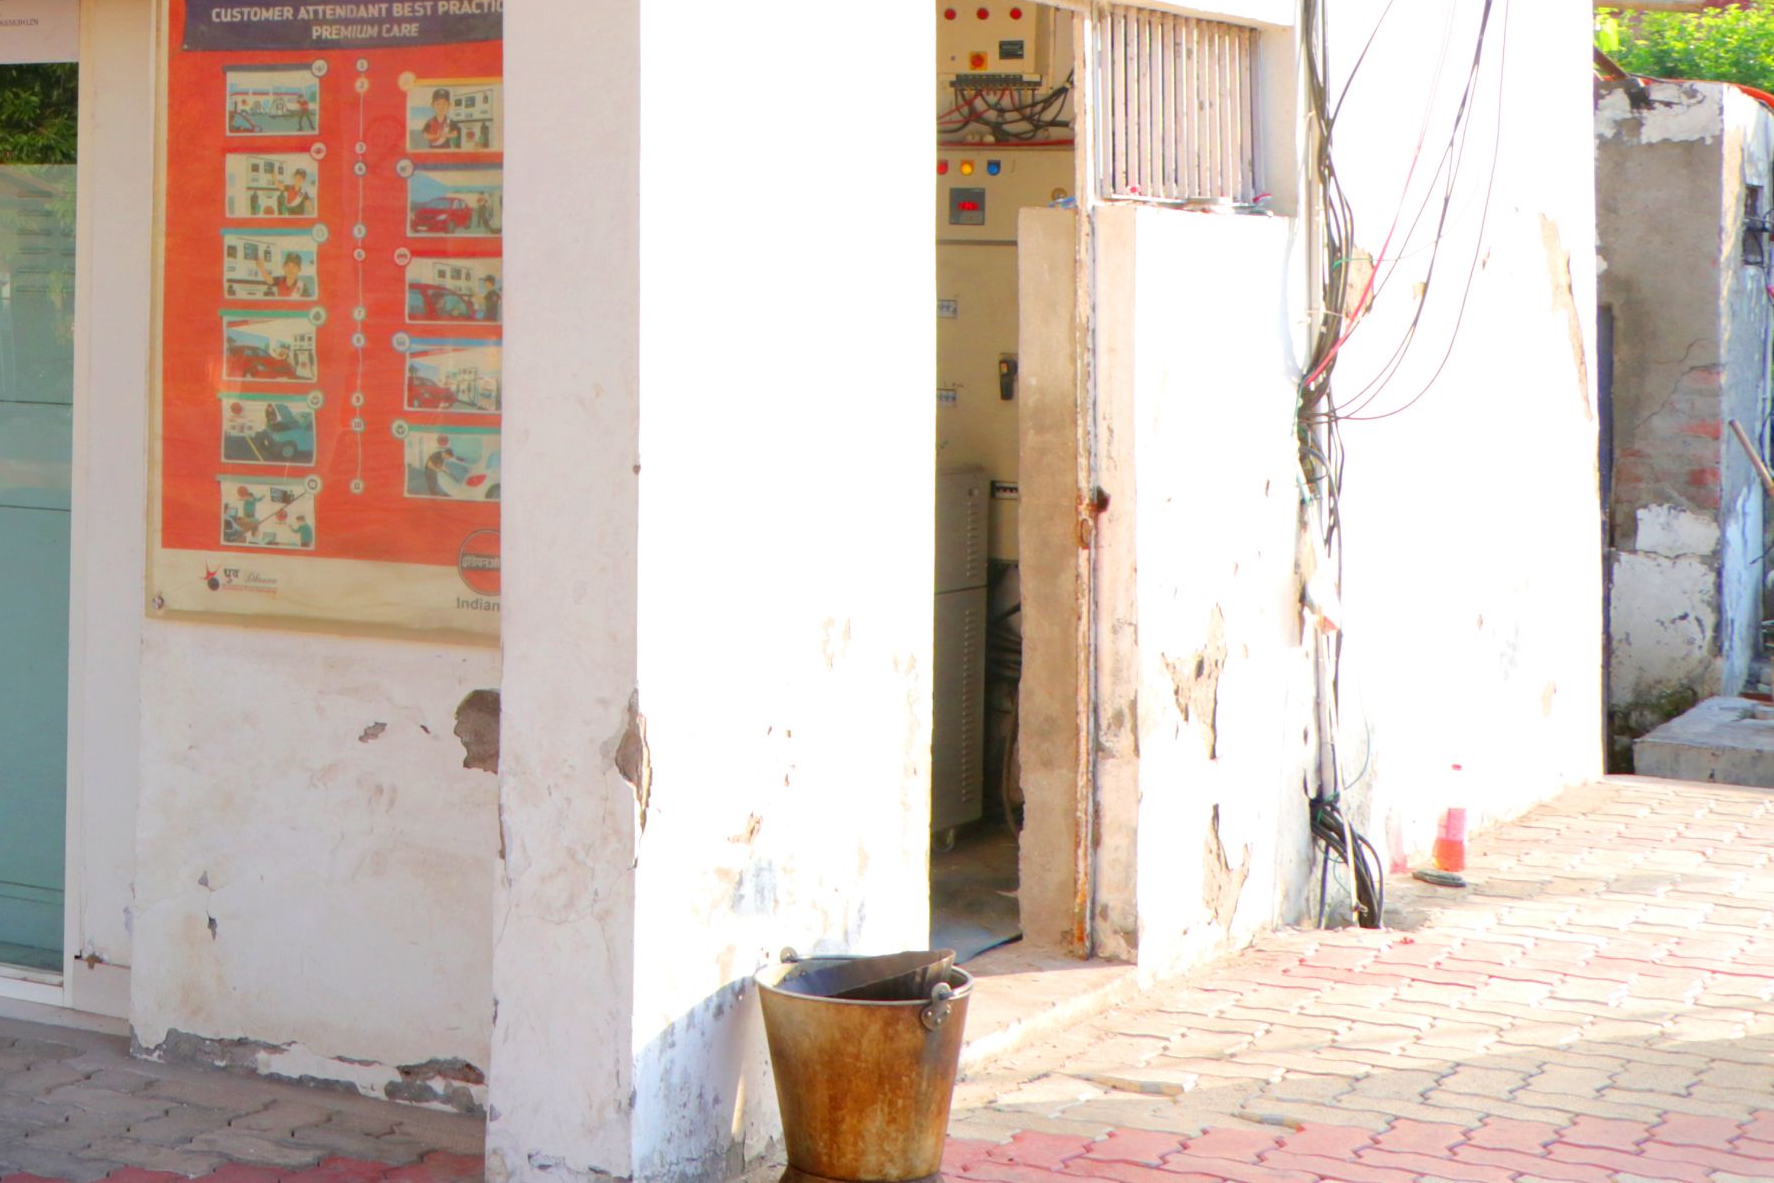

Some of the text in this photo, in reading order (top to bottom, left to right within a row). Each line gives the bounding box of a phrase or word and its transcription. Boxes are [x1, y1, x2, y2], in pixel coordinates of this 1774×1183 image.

[211, 6, 294, 22] CUSTOMER
[297, 2, 389, 21] ATTENDANT
[392, 1, 435, 17] BEST
[312, 22, 420, 40] PREMIUM CARE
